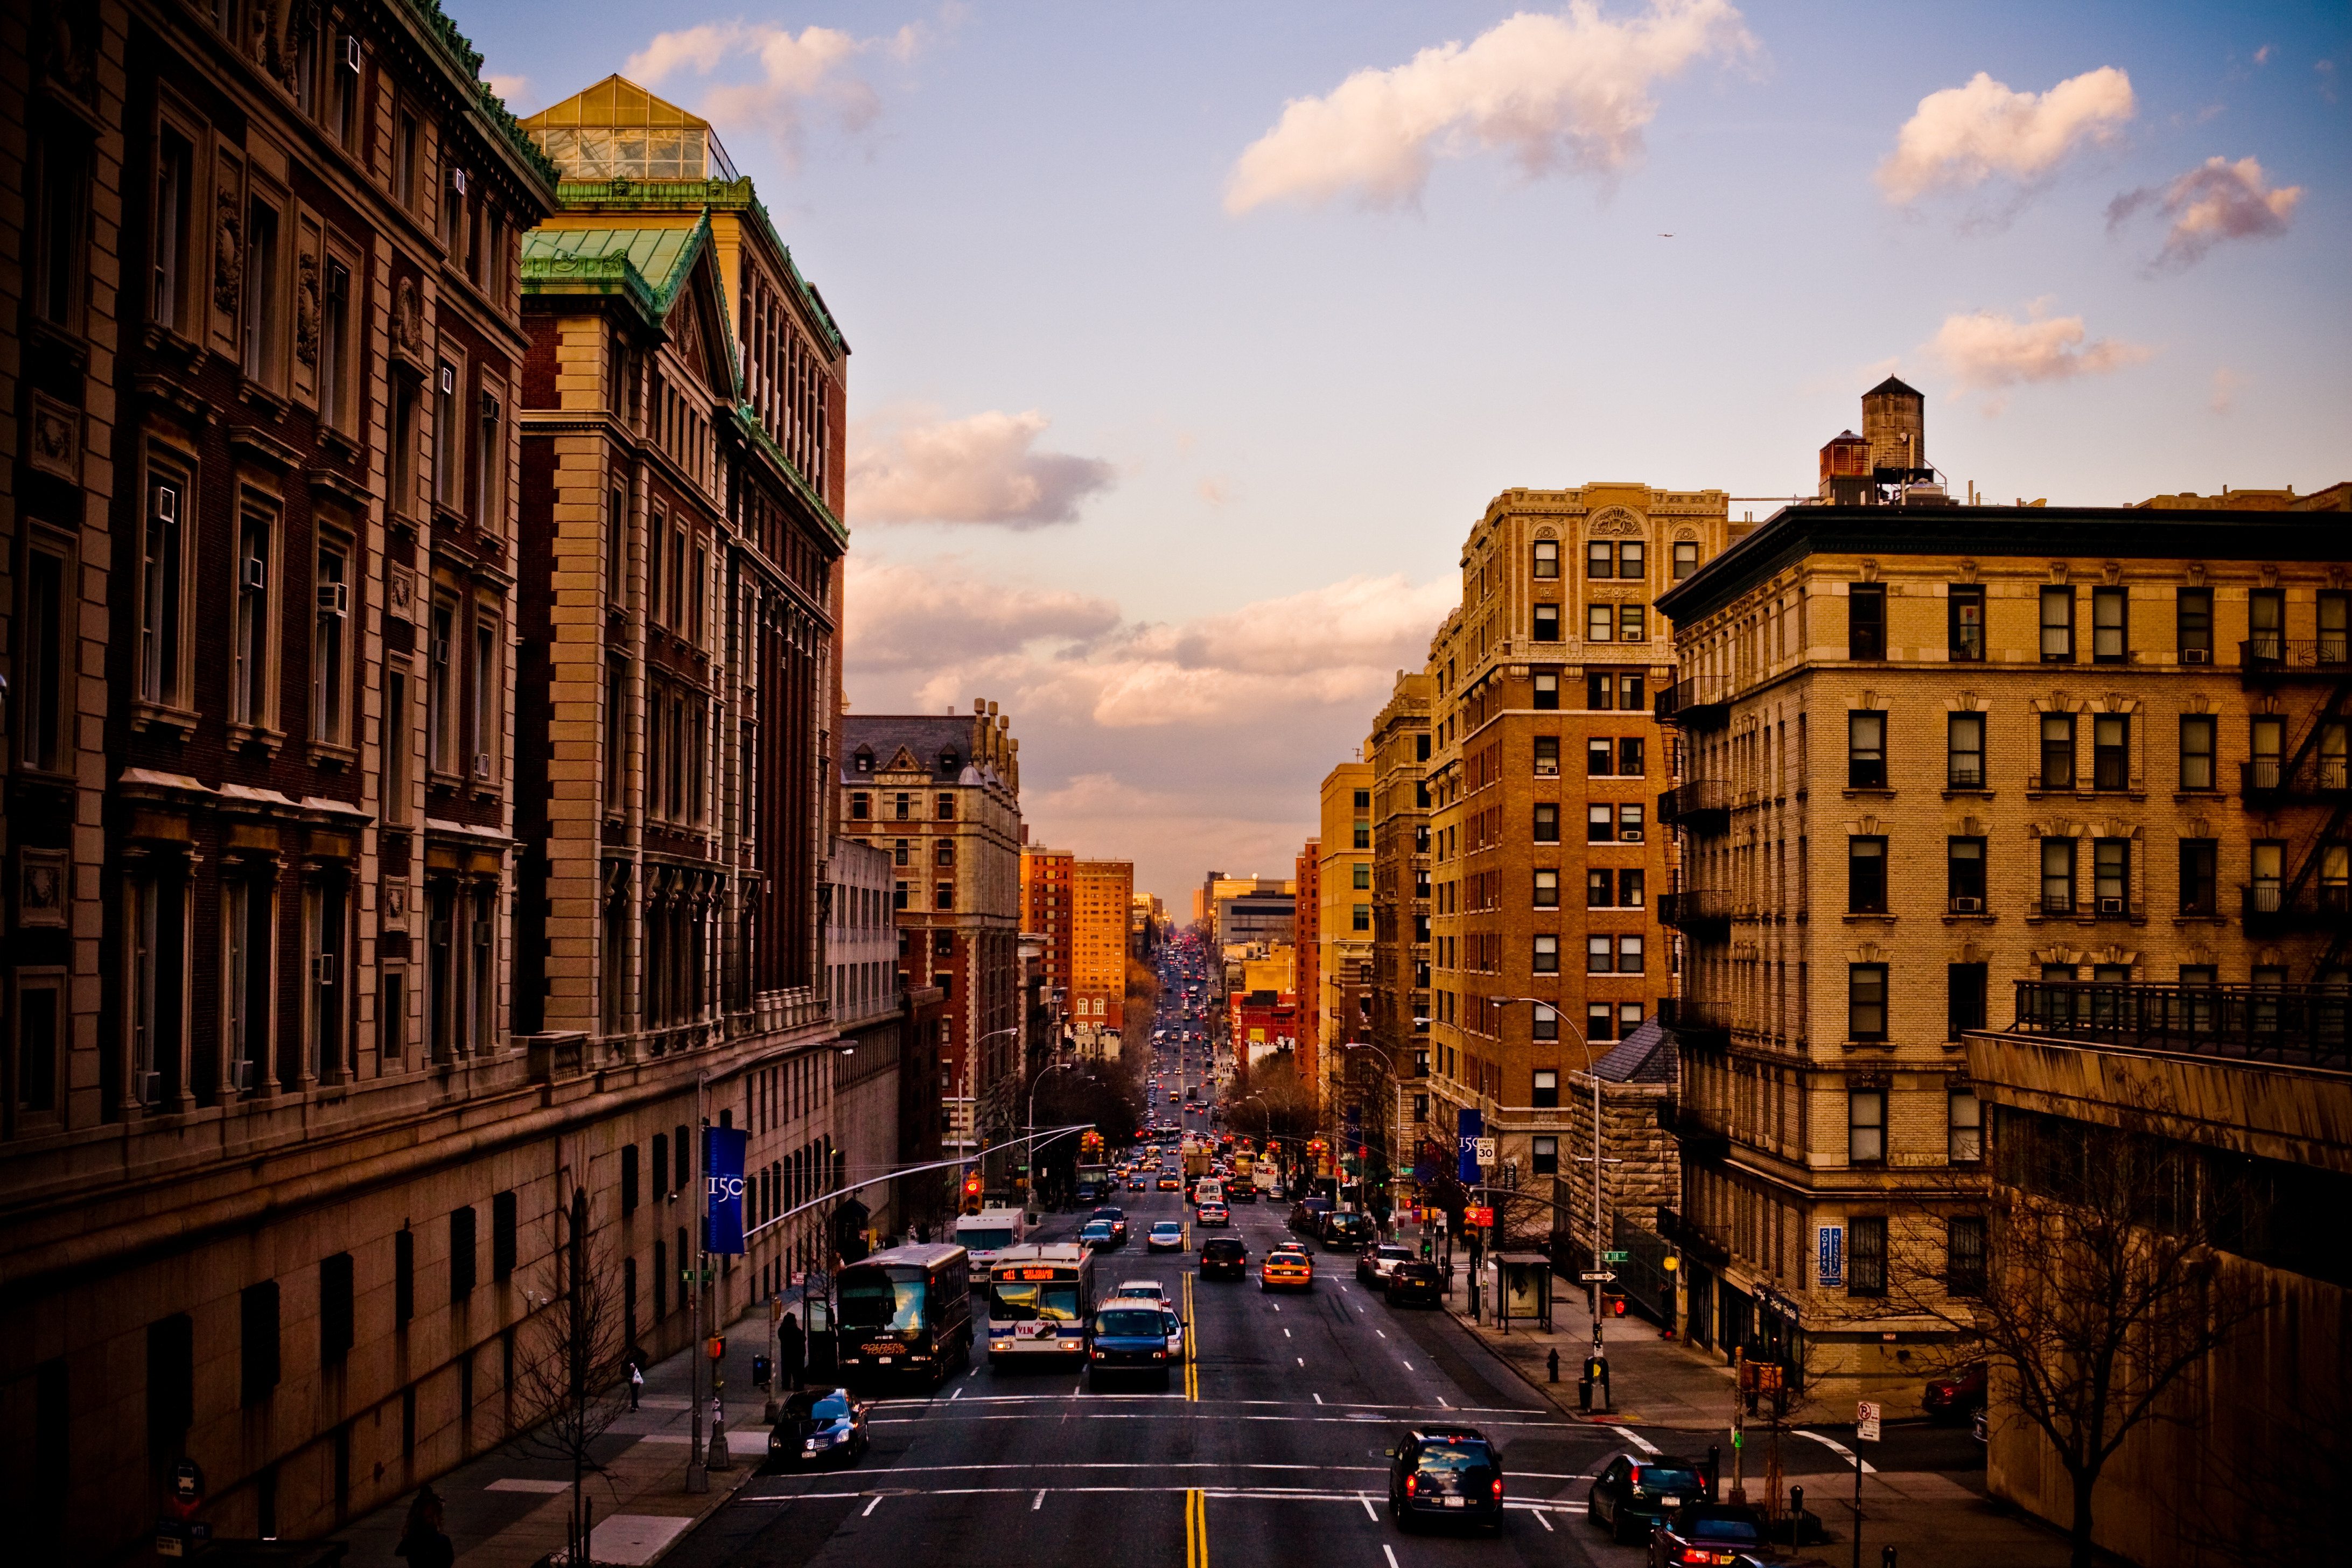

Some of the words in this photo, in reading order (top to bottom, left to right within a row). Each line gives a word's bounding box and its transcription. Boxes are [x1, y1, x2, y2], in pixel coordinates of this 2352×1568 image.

[1479, 1149, 1493, 1158] 30
[708, 1177, 744, 1203] 150
[1611, 1252, 1619, 1261] 118
[683, 1271, 689, 1280] W
[1003, 1269, 1016, 1280] M11
[191, 1524, 204, 1537] M11
